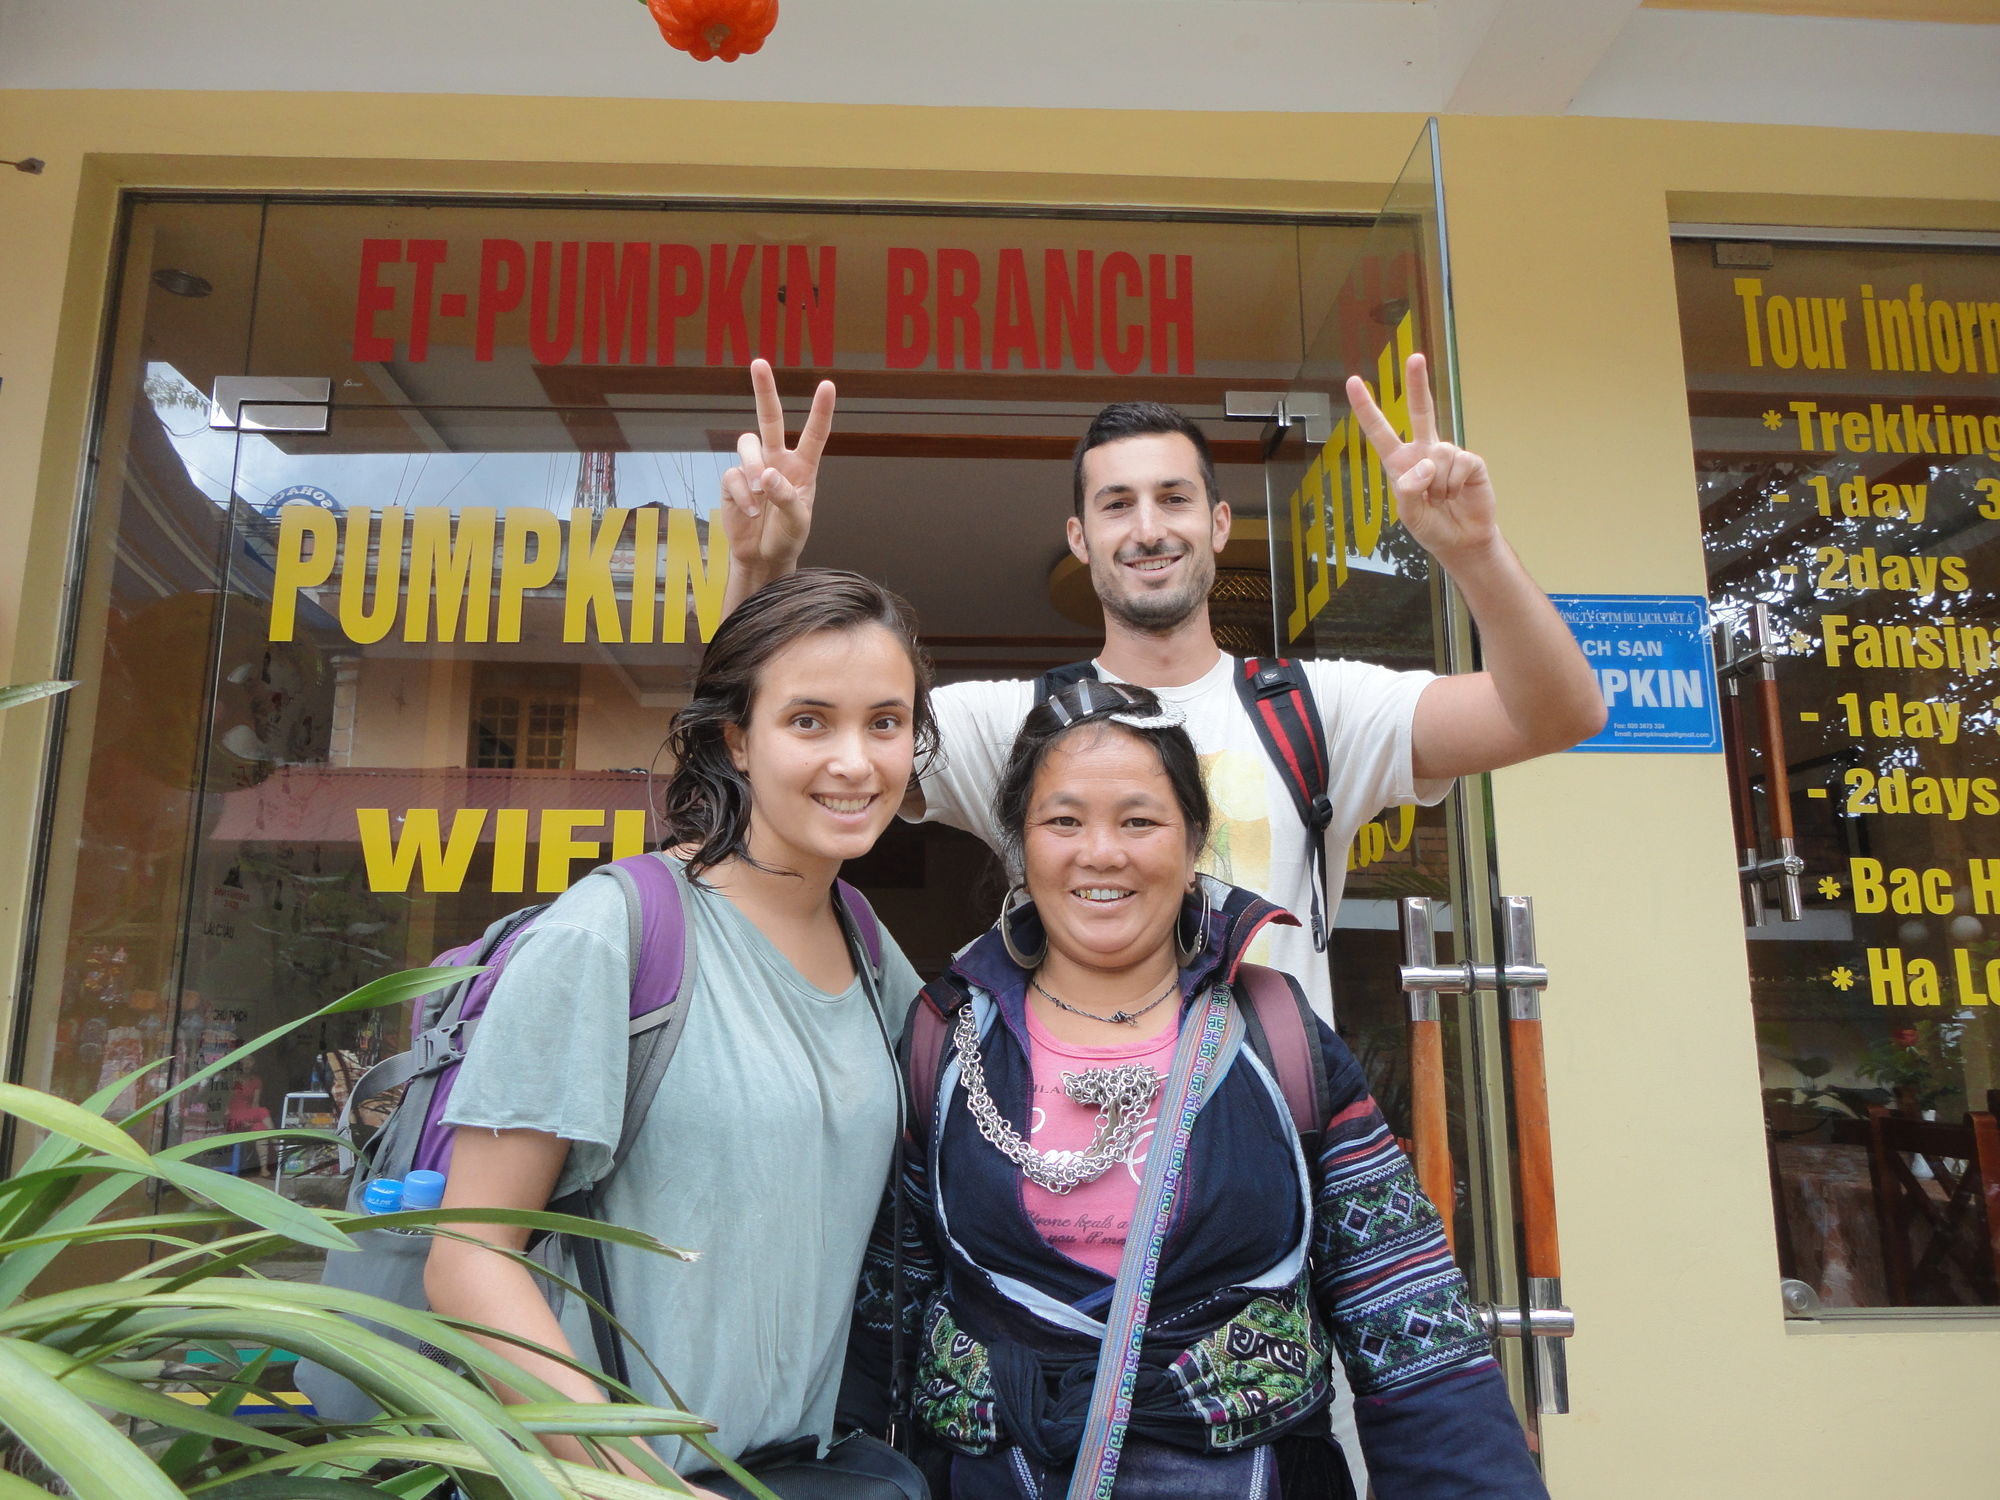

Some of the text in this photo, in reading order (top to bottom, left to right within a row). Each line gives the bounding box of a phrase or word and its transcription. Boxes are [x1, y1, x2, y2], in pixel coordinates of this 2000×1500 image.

[353, 238, 837, 367] ET-PUMPKIN
[885, 247, 1195, 375] BRANCH
[1734, 277, 1847, 370] Tour
[1808, 475, 1927, 524] 1day
[269, 506, 730, 644] PUMPKIN
[1816, 546, 1969, 596] 2days
[1582, 640, 1611, 656] CH
[1821, 615, 2000, 676] Fansip
[1837, 693, 1960, 744] 1day
[1844, 768, 2000, 820] 2days
[356, 808, 646, 893] WIFI
[1850, 857, 1955, 915] Bac
[1866, 947, 1941, 1006] Ha
